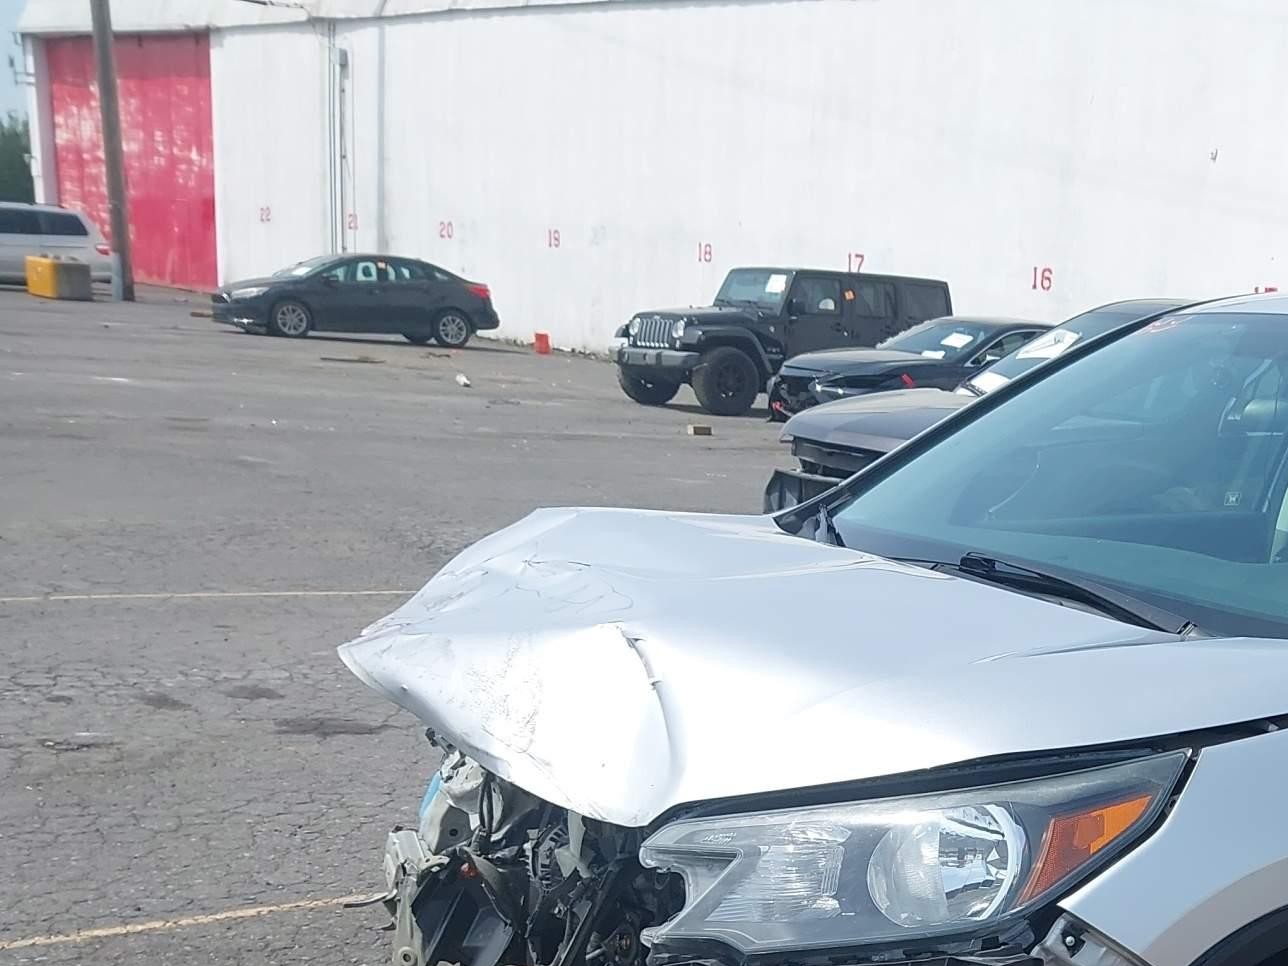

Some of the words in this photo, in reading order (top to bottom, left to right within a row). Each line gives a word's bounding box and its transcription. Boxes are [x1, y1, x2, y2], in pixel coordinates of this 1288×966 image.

[438, 220, 454, 240] 20
[548, 228, 561, 248] 19
[698, 241, 713, 262] 18
[848, 252, 865, 273] 17
[1031, 266, 1053, 291] 16
